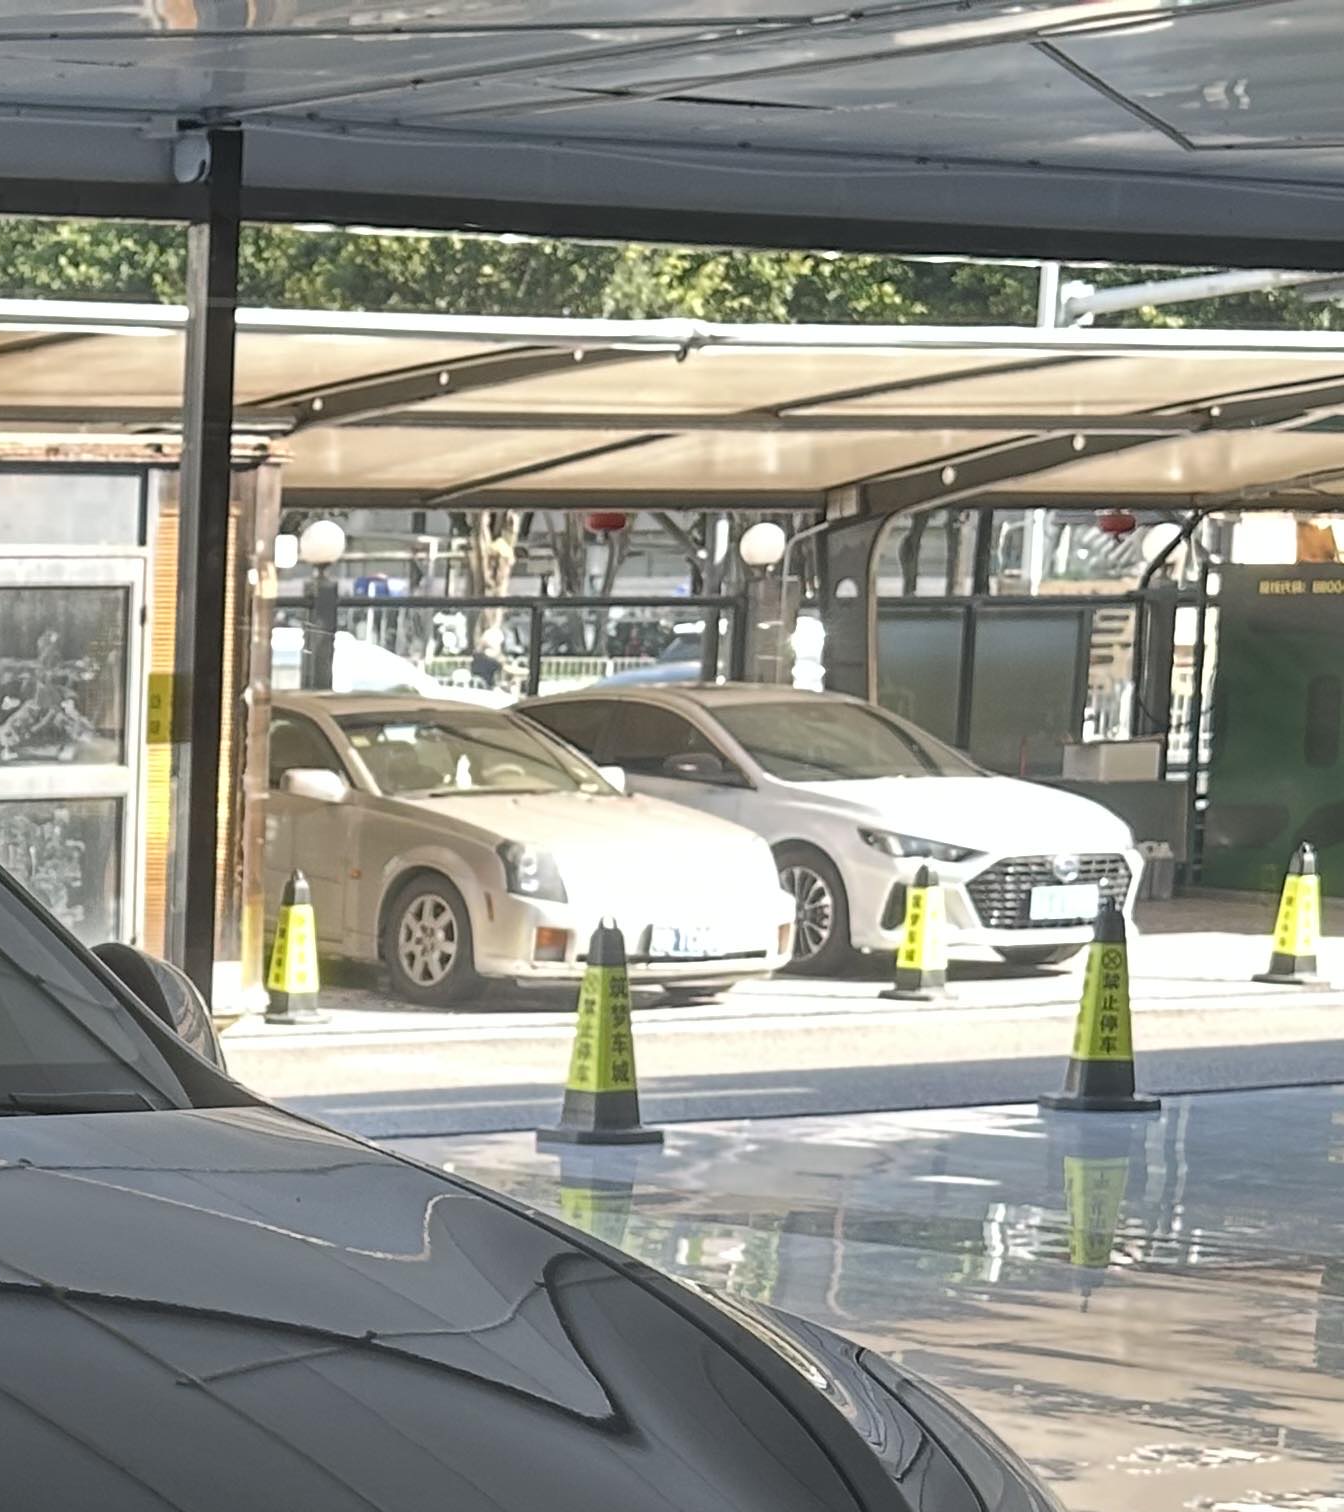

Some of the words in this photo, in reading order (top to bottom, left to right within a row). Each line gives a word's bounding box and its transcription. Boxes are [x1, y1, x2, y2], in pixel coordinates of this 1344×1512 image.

[609, 976, 630, 1083] 筑梦车城
[1099, 973, 1121, 1056] 禁止停车
